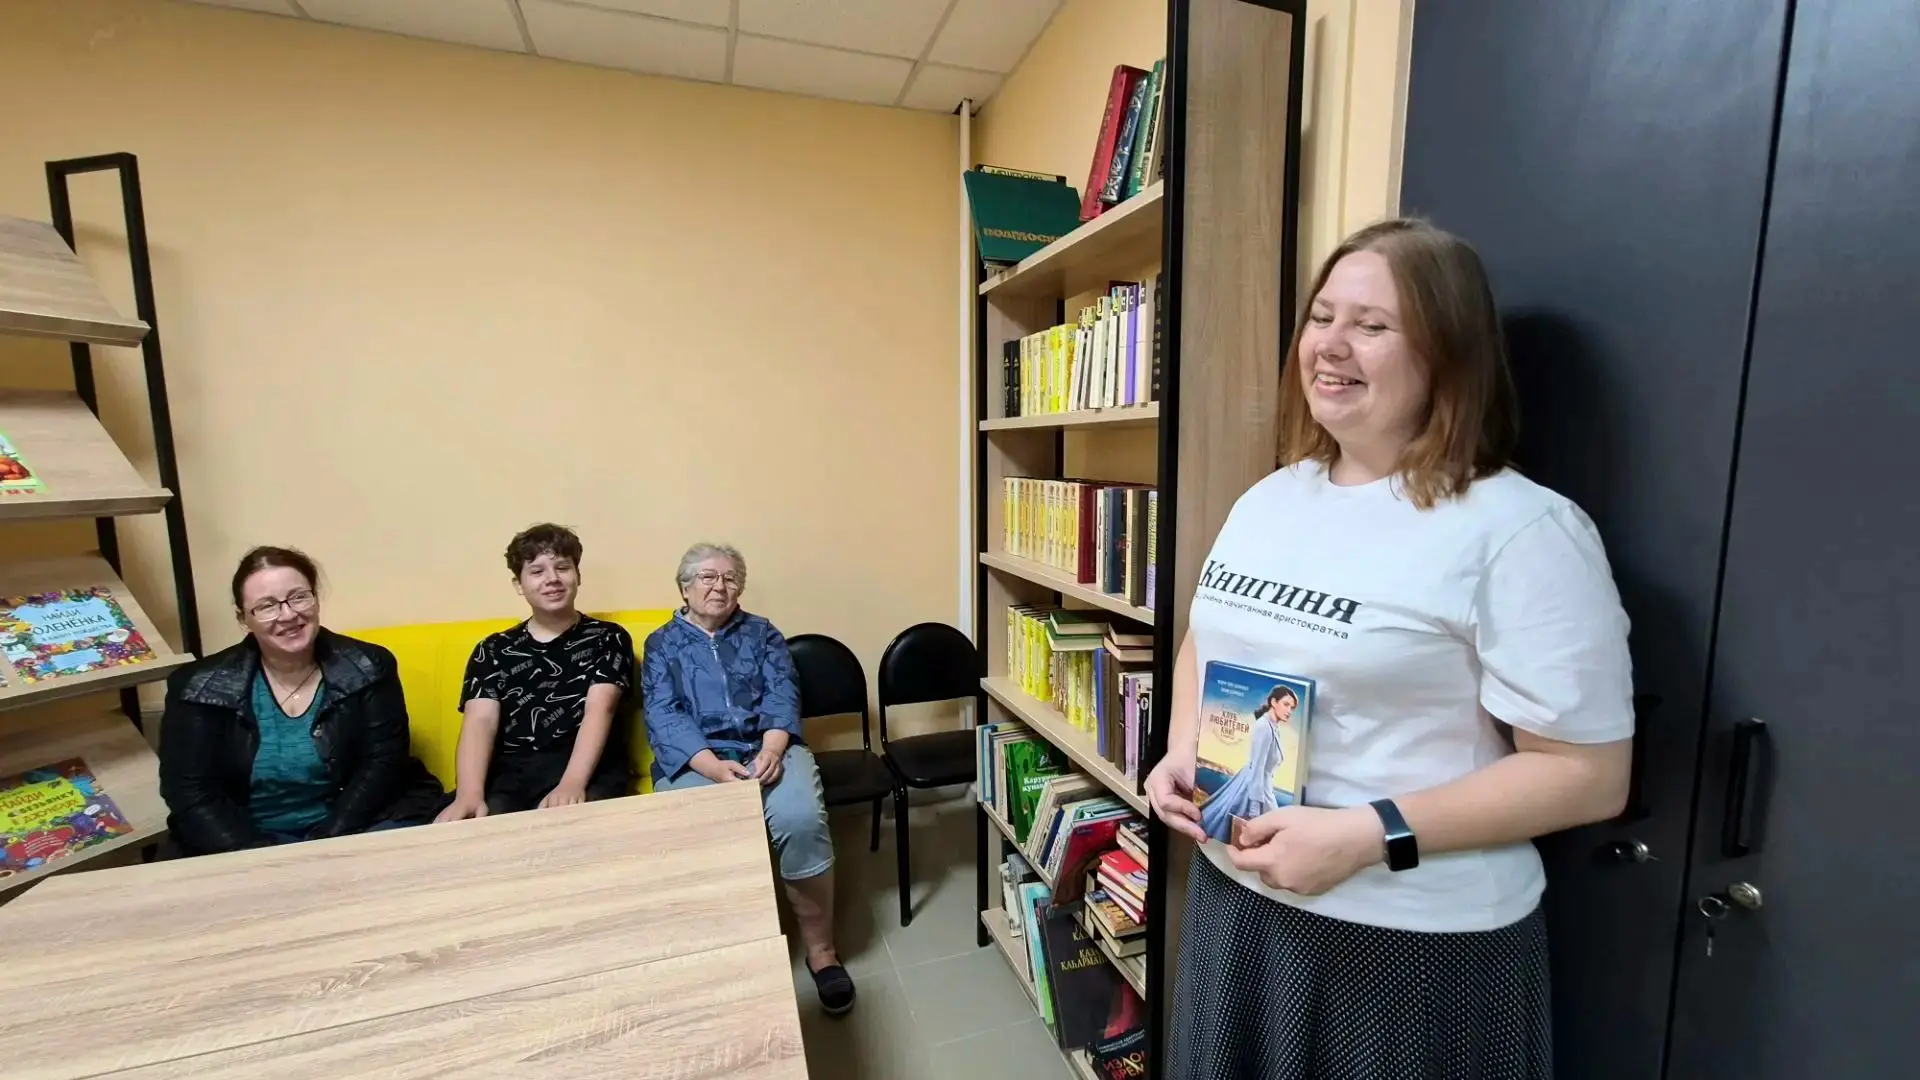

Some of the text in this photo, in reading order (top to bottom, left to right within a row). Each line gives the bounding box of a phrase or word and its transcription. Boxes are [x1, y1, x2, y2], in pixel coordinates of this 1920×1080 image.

[1202, 594, 1349, 640] очень начитанная аристократка
[1210, 714, 1250, 734] ЛЮБИТЕЛЕЙ
[1222, 711, 1237, 721] КЛУБ
[1103, 1050, 1145, 1070] ИЗЛО
